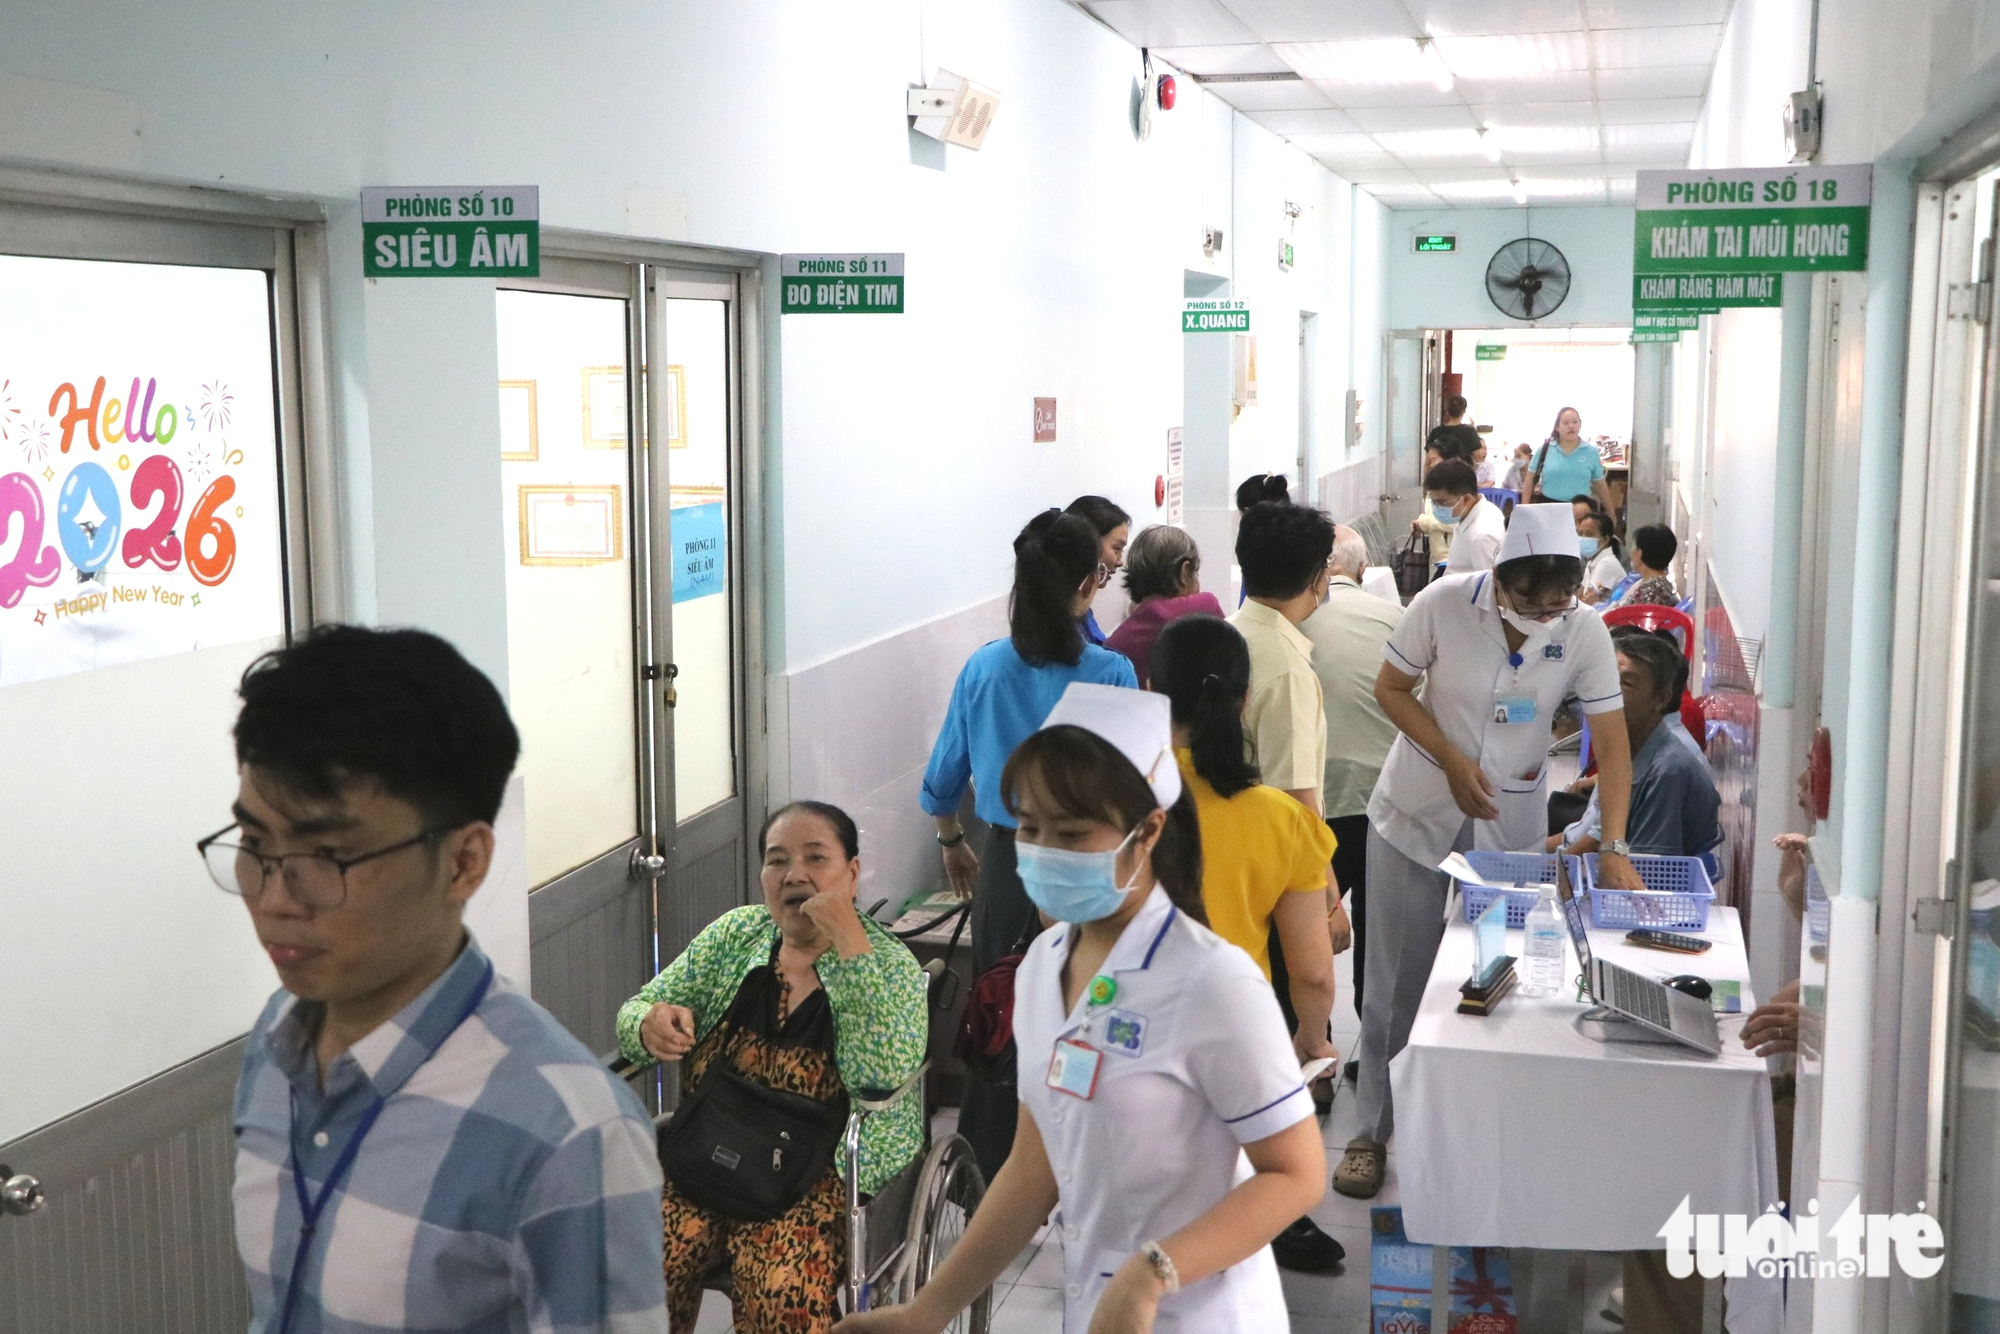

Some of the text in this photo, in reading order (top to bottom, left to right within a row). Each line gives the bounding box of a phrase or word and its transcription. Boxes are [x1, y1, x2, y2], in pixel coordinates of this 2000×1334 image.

[1667, 172, 1838, 203] PHÒNG SỐ 18
[386, 190, 514, 217] PHÒNG SỐ 10
[375, 226, 528, 268] SIÊU ÂM
[1651, 219, 1849, 264] KHÁM TAI MŨI HỌNG
[798, 255, 887, 273] PHÒNG SỐ 11
[787, 280, 897, 310] ĐO ĐIỆN TIM
[1640, 273, 1774, 302] KHÁM RĂNG HÀM MẶT
[1187, 299, 1244, 309] PHÒNG SỐ 12
[1185, 313, 1246, 329] X.QUANG
[48, 375, 177, 454] Hello
[0, 454, 236, 609] 2026
[685, 538, 716, 554] PHÒNG 11
[687, 558, 702, 574] SIÊU
[54, 585, 185, 620] Happy New Year
